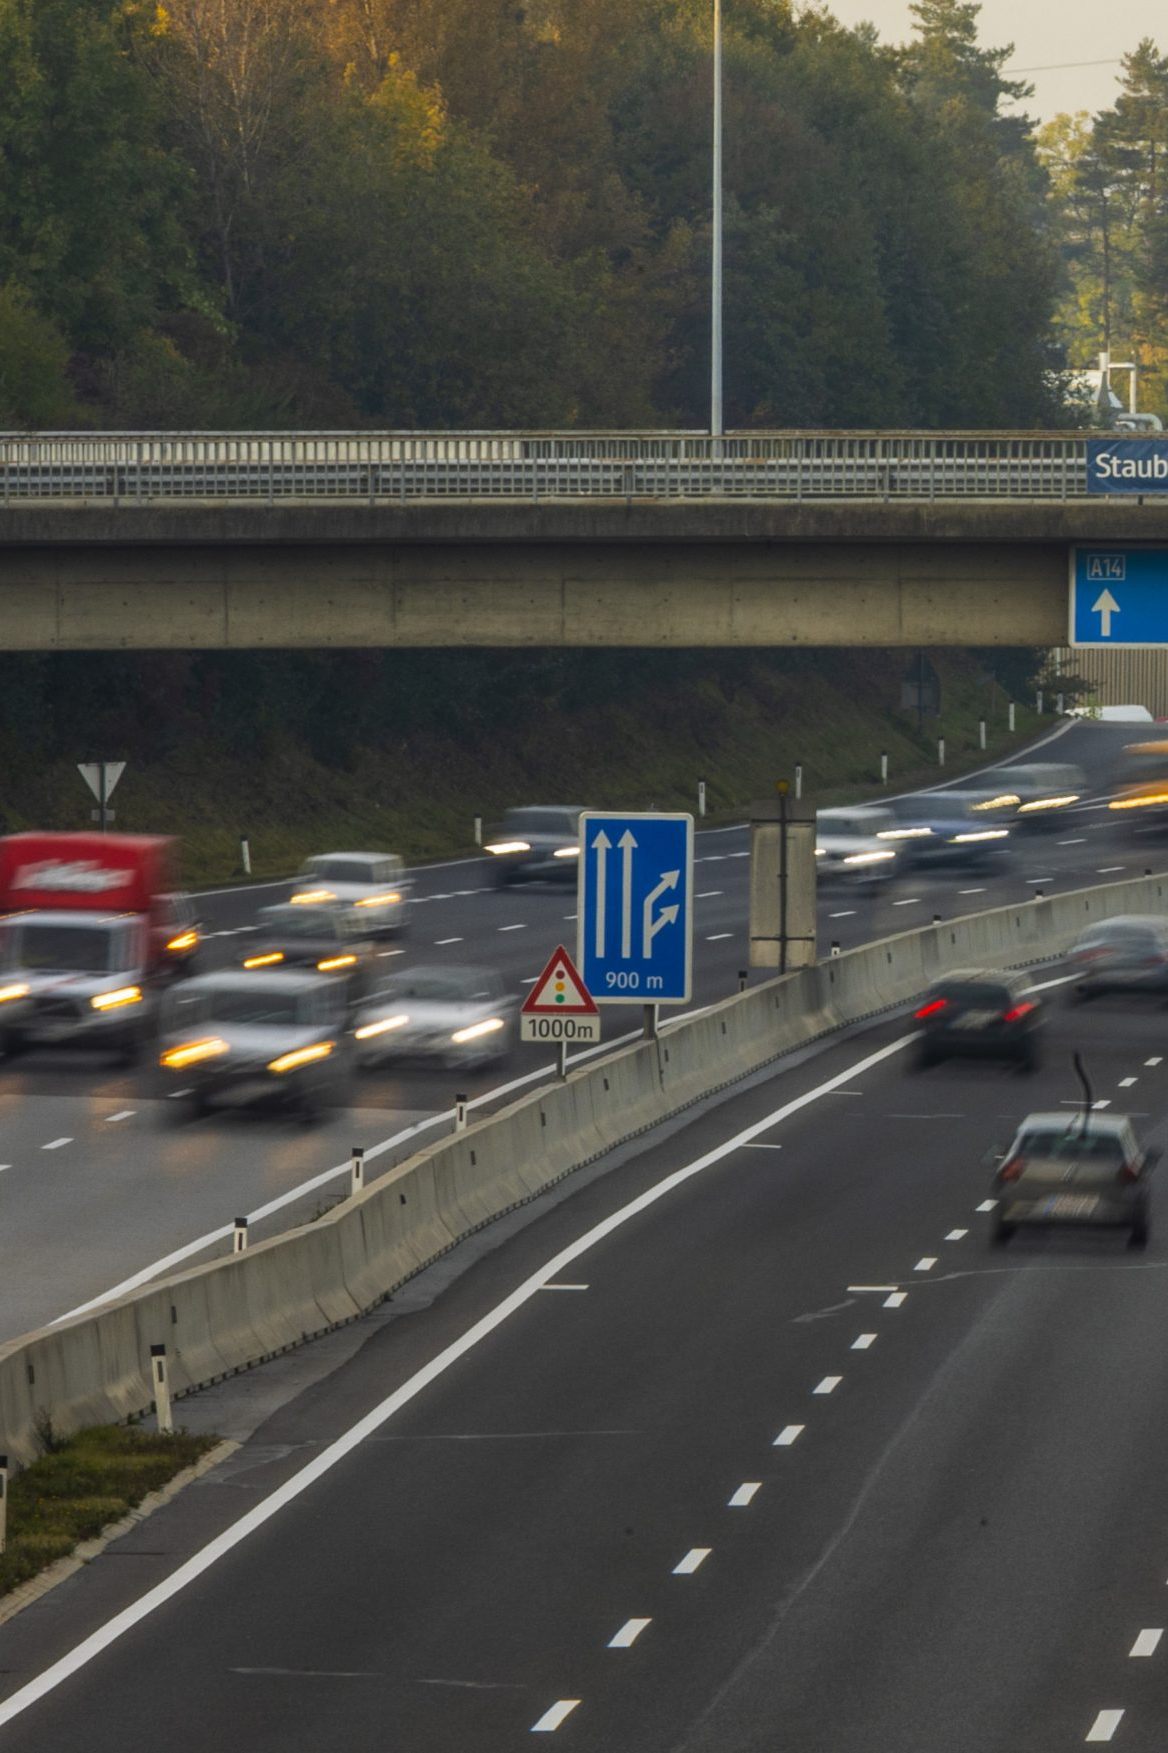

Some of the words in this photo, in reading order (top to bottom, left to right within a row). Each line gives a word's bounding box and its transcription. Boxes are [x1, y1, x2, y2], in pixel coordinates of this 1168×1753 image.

[1091, 558, 1123, 578] A14
[606, 972, 639, 989] 900
[647, 974, 663, 989] m
